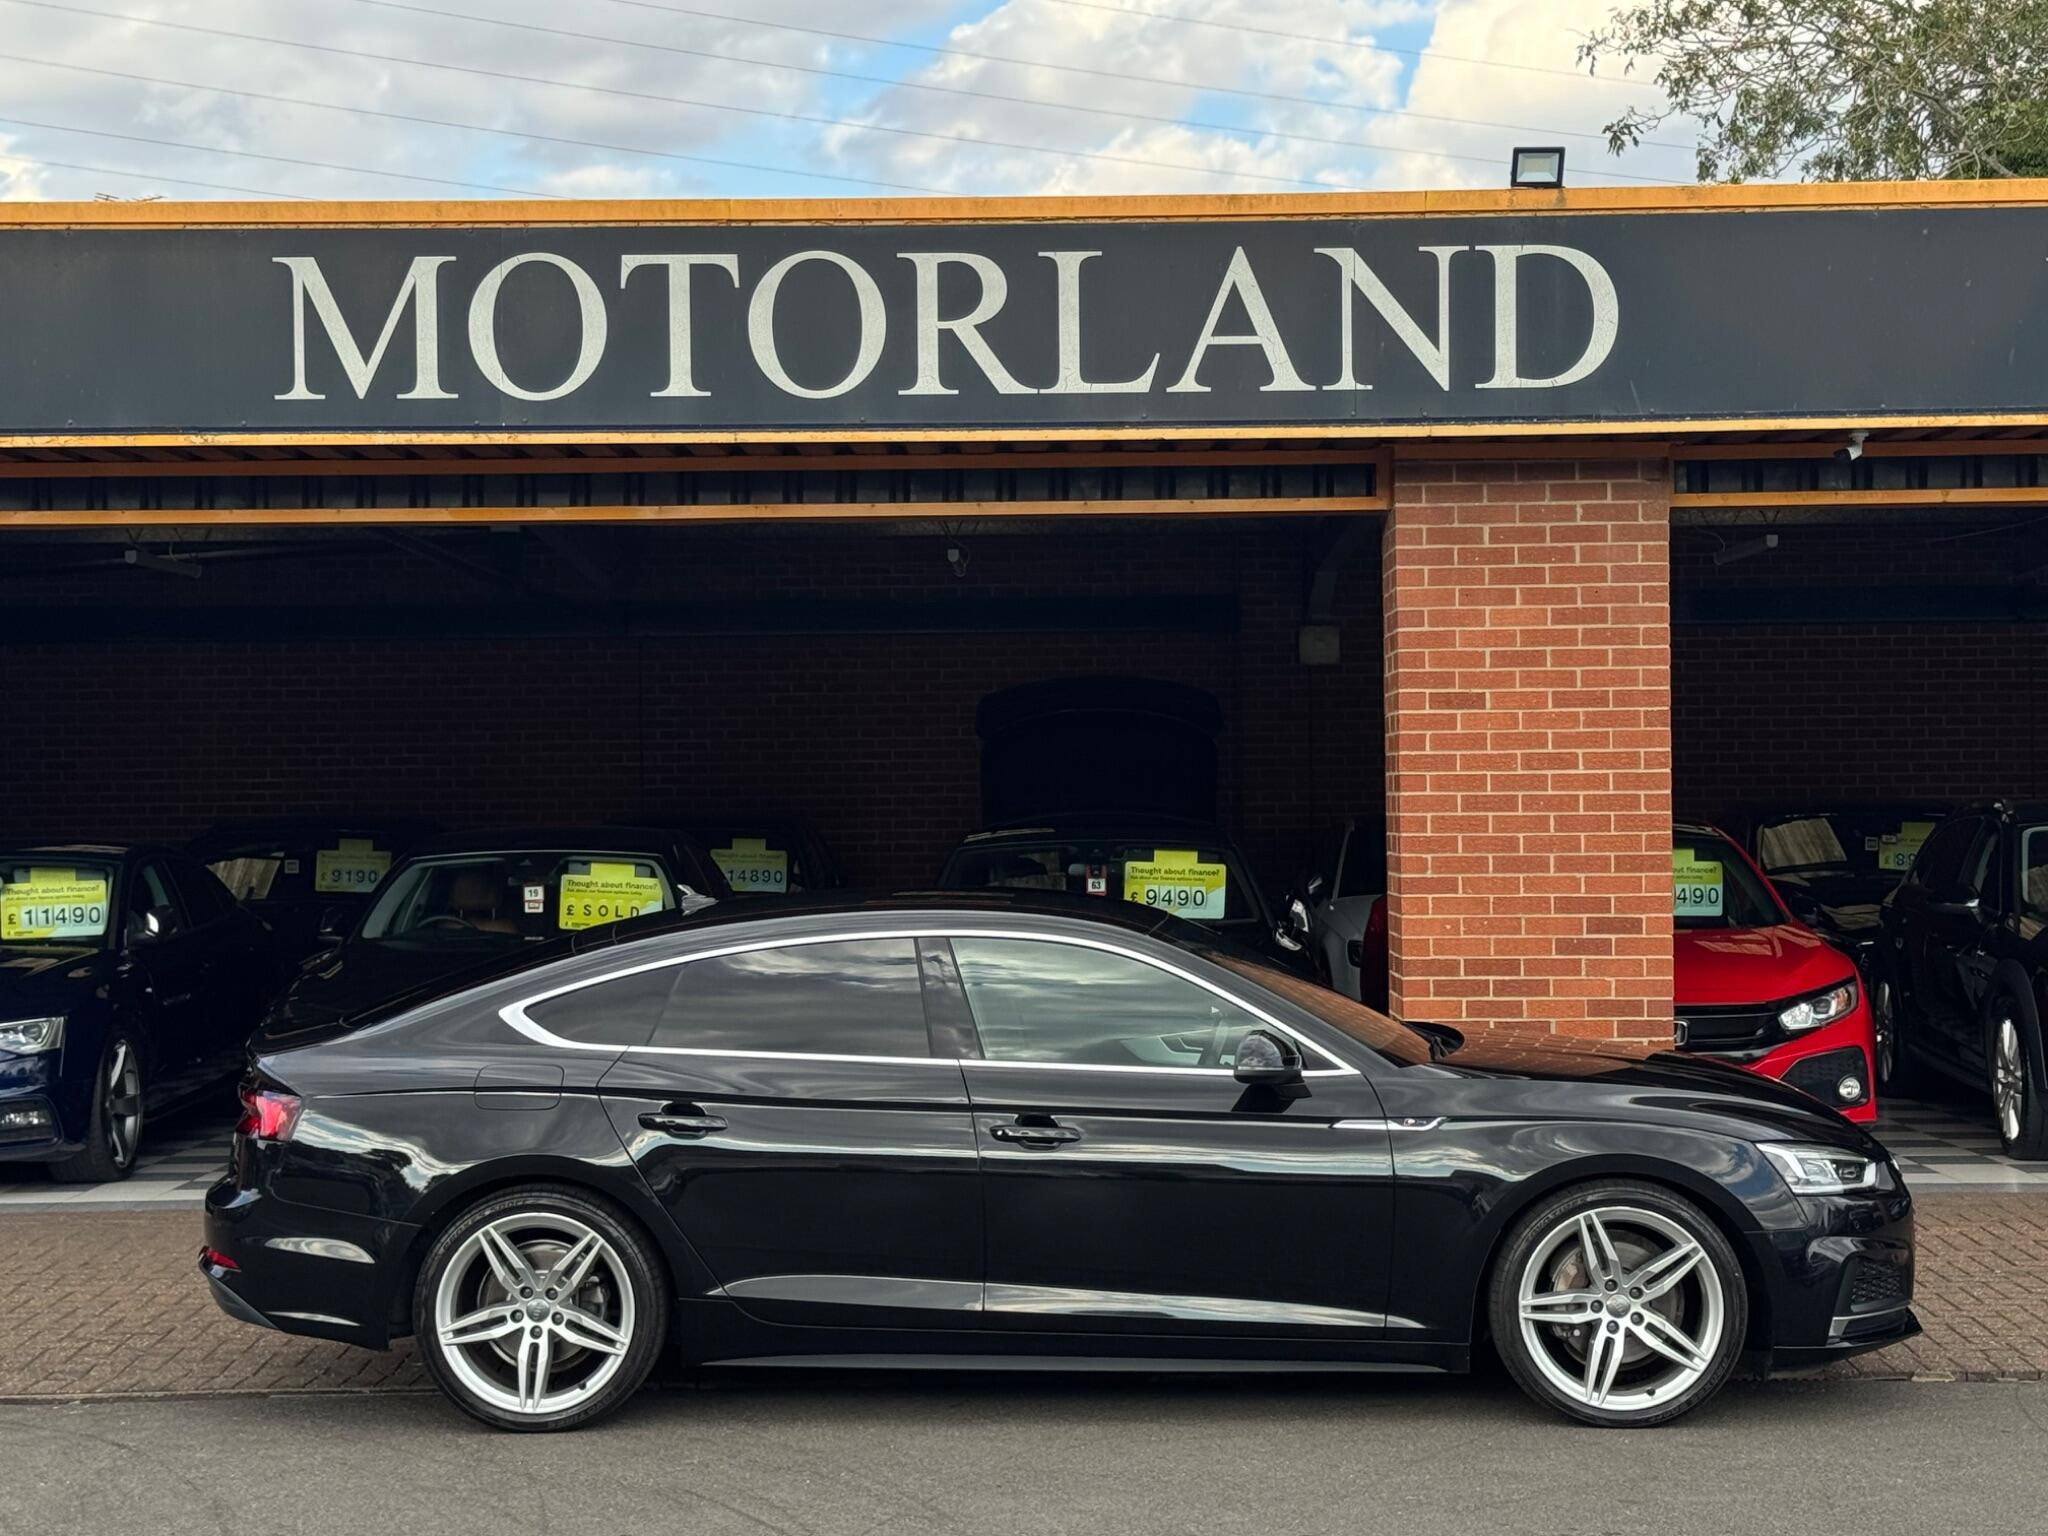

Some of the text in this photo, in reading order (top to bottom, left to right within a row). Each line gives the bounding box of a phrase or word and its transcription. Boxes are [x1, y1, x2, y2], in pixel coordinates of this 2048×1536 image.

[272, 245, 1620, 402] MOTORLAND
[332, 869, 378, 883] 9190
[728, 869, 783, 883] 14890
[1131, 866, 1220, 877] Thought about finance?
[1686, 866, 1718, 874] finance?
[5, 887, 40, 896] Thought
[66, 885, 100, 893] finance?
[567, 880, 658, 890] Thought about finance?
[1091, 881, 1101, 890] 63
[527, 888, 539, 898] 19
[1145, 888, 1205, 907] 9490
[1676, 887, 1719, 904] 490
[24, 906, 101, 926] 11490
[583, 903, 640, 918] SOLD
